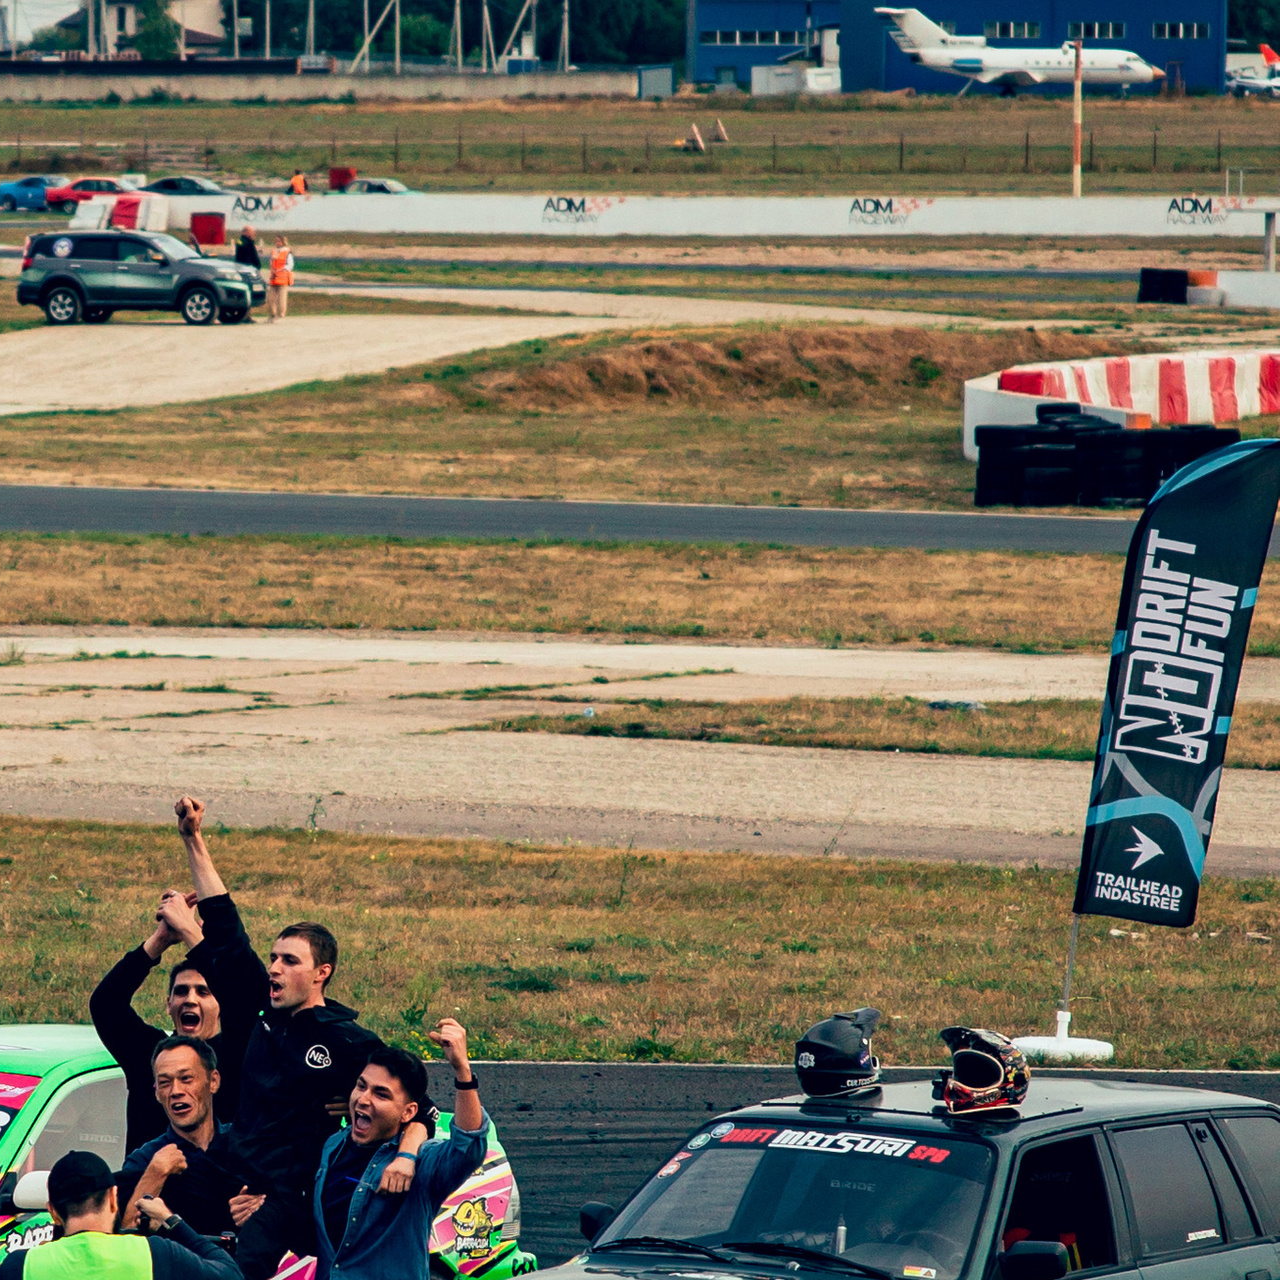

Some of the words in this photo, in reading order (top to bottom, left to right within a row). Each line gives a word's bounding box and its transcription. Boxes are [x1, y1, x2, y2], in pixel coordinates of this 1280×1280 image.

[232, 197, 273, 212] ADM
[542, 197, 586, 212] ADM
[849, 198, 894, 214] ADM
[1167, 198, 1213, 214] ADM
[848, 214, 909, 225] RACEWAY
[1166, 214, 1229, 225] RACEWAY
[1131, 529, 1197, 652] DRIFT
[1180, 577, 1239, 663] FUN
[1095, 871, 1183, 899] TRAILHEAD
[1094, 885, 1181, 912] INDASTREE
[719, 1129, 779, 1144] DRIFT
[768, 1129, 917, 1157] MATSURI
[908, 1145, 951, 1163] SPB
[830, 1179, 876, 1193] BRIDE
